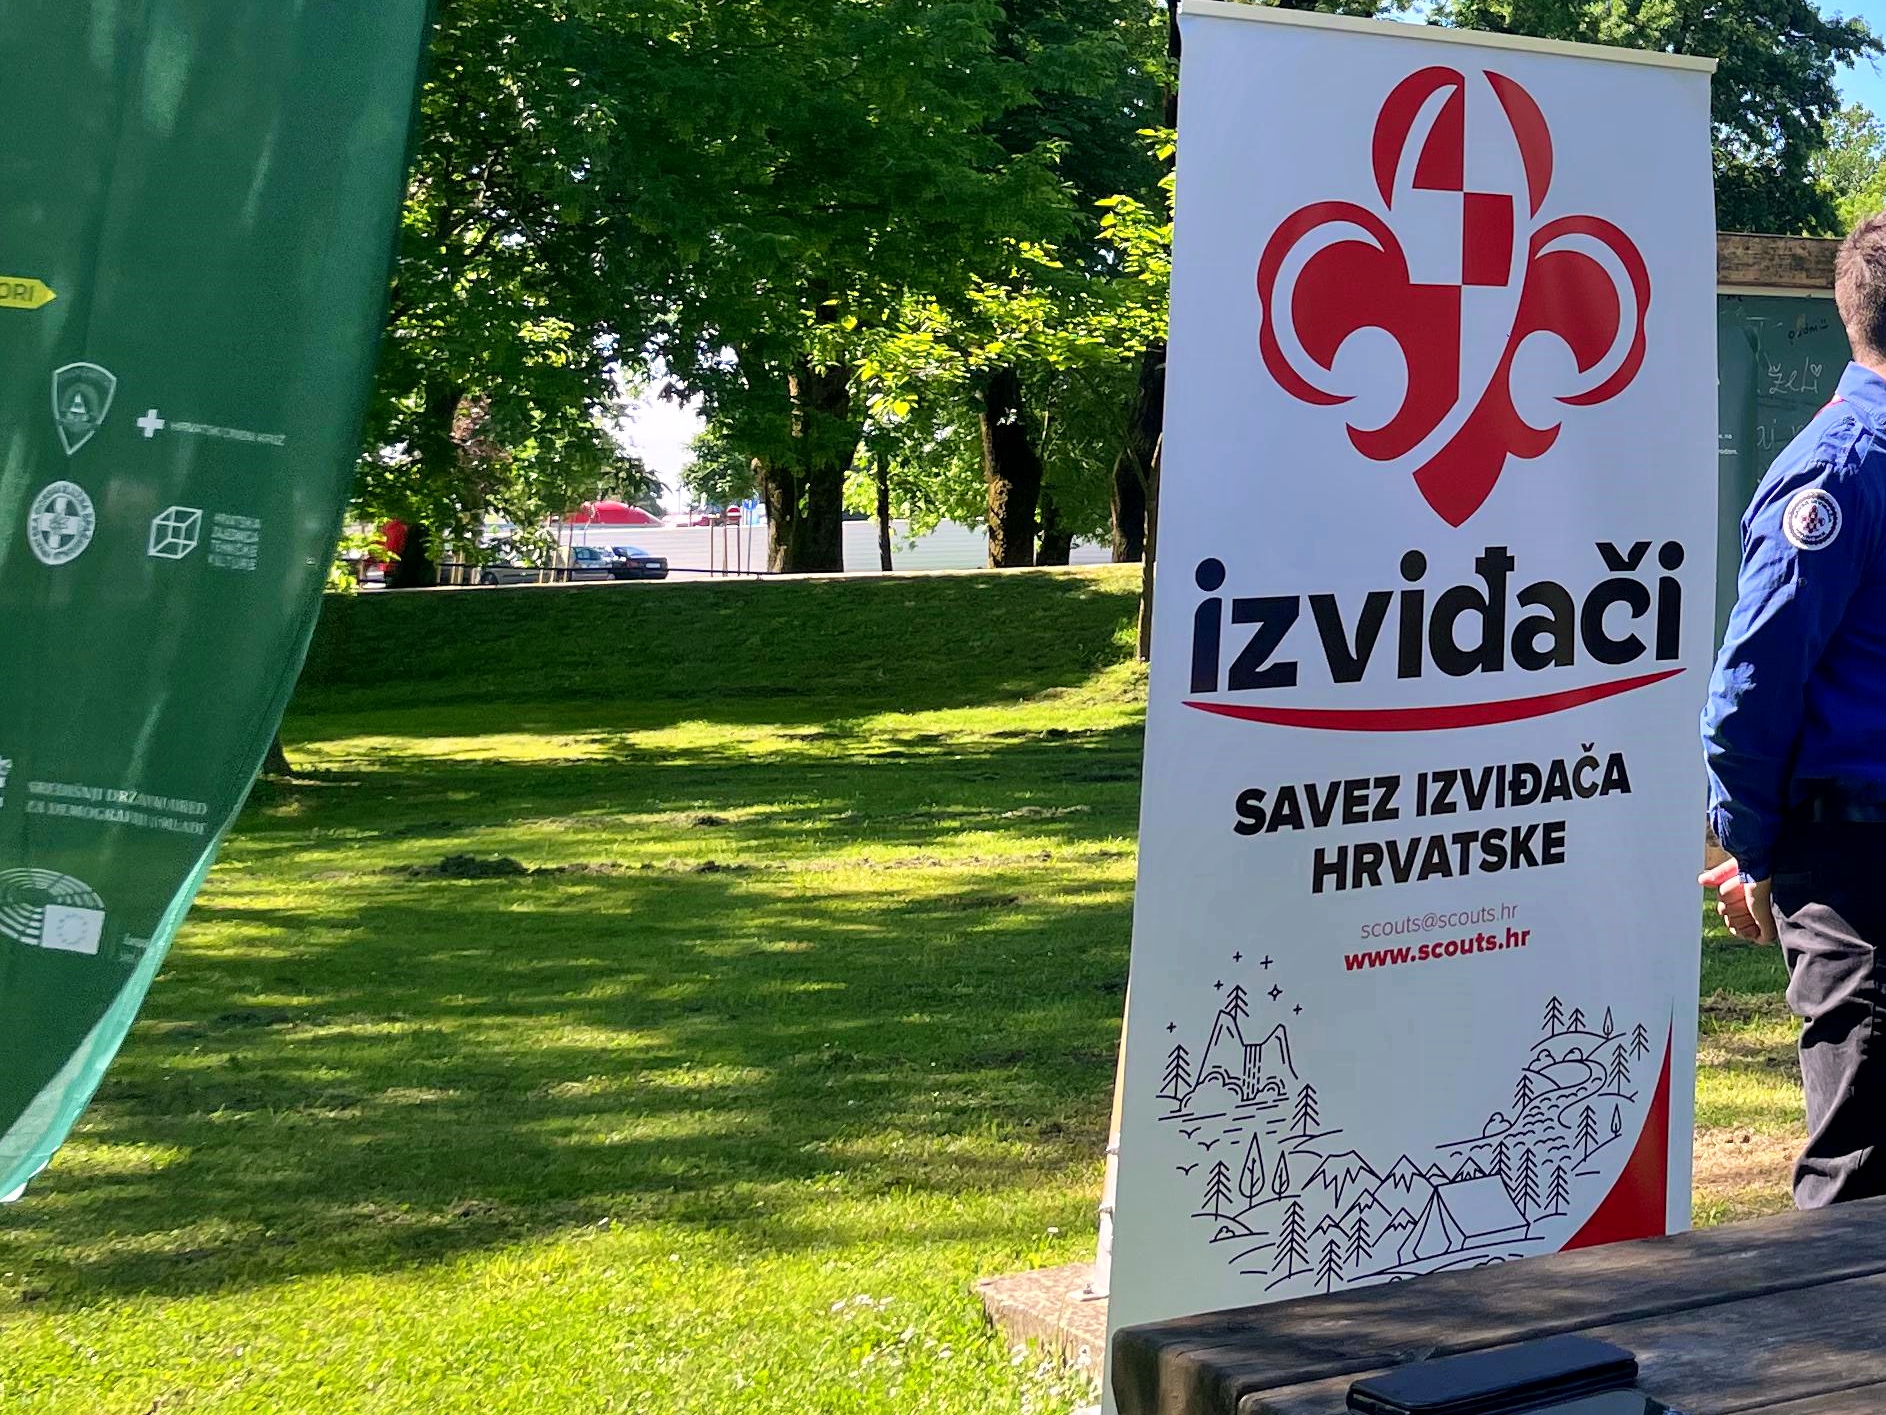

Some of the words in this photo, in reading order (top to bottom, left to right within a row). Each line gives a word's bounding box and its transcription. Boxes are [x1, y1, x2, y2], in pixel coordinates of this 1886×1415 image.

[1189, 539, 1685, 694] izviđači
[1232, 775, 1400, 837] SAVEZ
[1416, 742, 1632, 818] IZVIĐAČA
[1311, 820, 1567, 894] HRVATSKE
[1343, 926, 1531, 972] www.scouts.hr
[1360, 901, 1519, 940] scouts@scouts.hr
